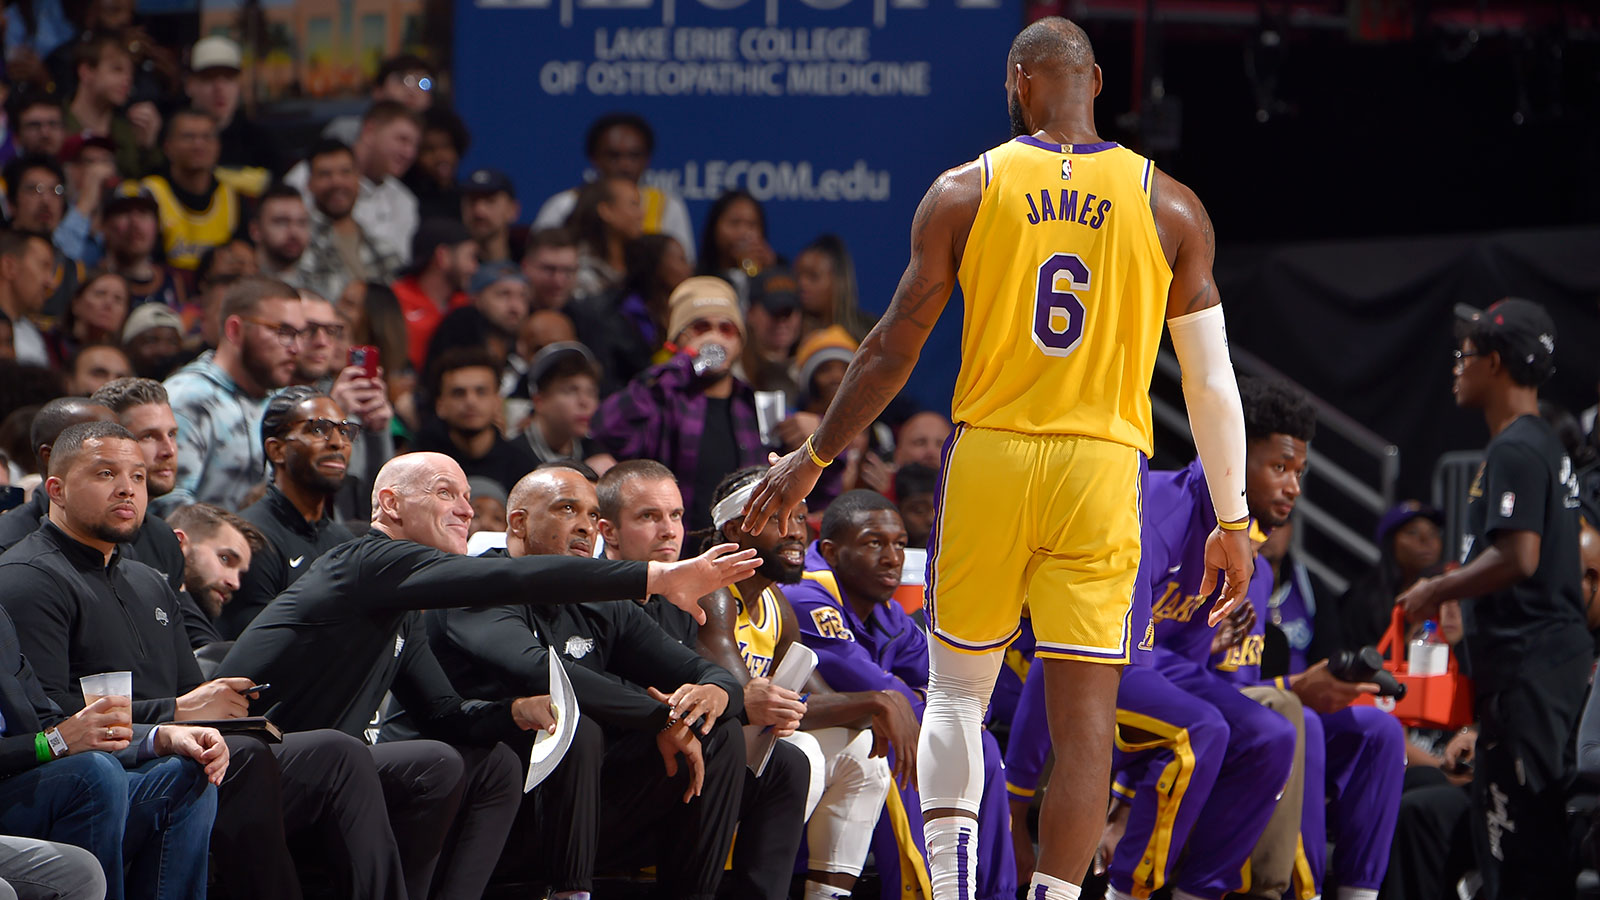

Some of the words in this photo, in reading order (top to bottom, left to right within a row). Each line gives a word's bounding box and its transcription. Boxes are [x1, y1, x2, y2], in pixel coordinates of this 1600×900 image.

[595, 28, 669, 60] LAKE
[673, 28, 736, 60] ERIE
[740, 28, 870, 60] COLLEGE
[540, 62, 580, 94] OF
[586, 62, 783, 94] OSTEOPATHIC
[787, 62, 930, 94] MEDICINE
[1025, 189, 1112, 229] JAMES
[1031, 251, 1092, 357] 6
